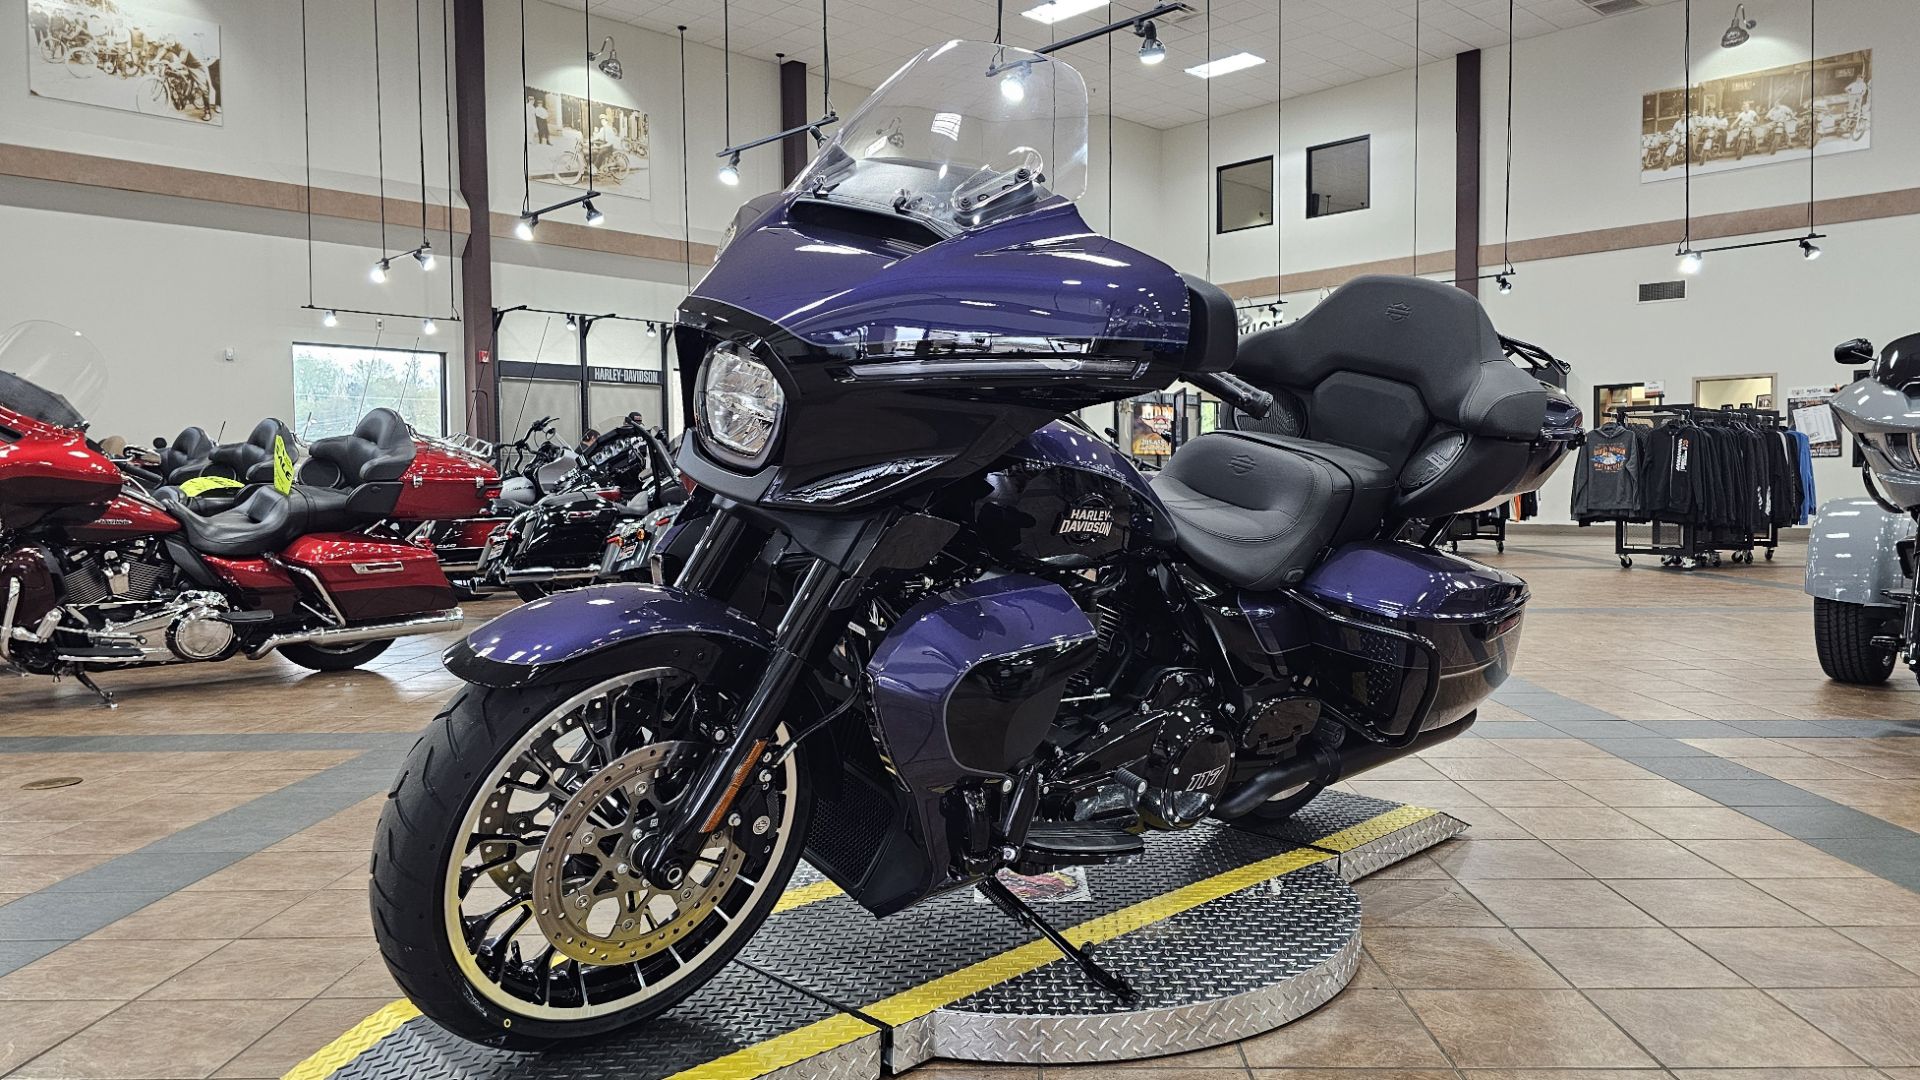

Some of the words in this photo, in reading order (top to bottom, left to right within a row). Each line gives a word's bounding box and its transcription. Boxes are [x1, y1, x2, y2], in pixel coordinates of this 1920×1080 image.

[594, 367, 659, 384] HARLEY-DAVIDSON
[1059, 519, 1113, 537] DAVIDSON
[1185, 764, 1226, 792] 117
